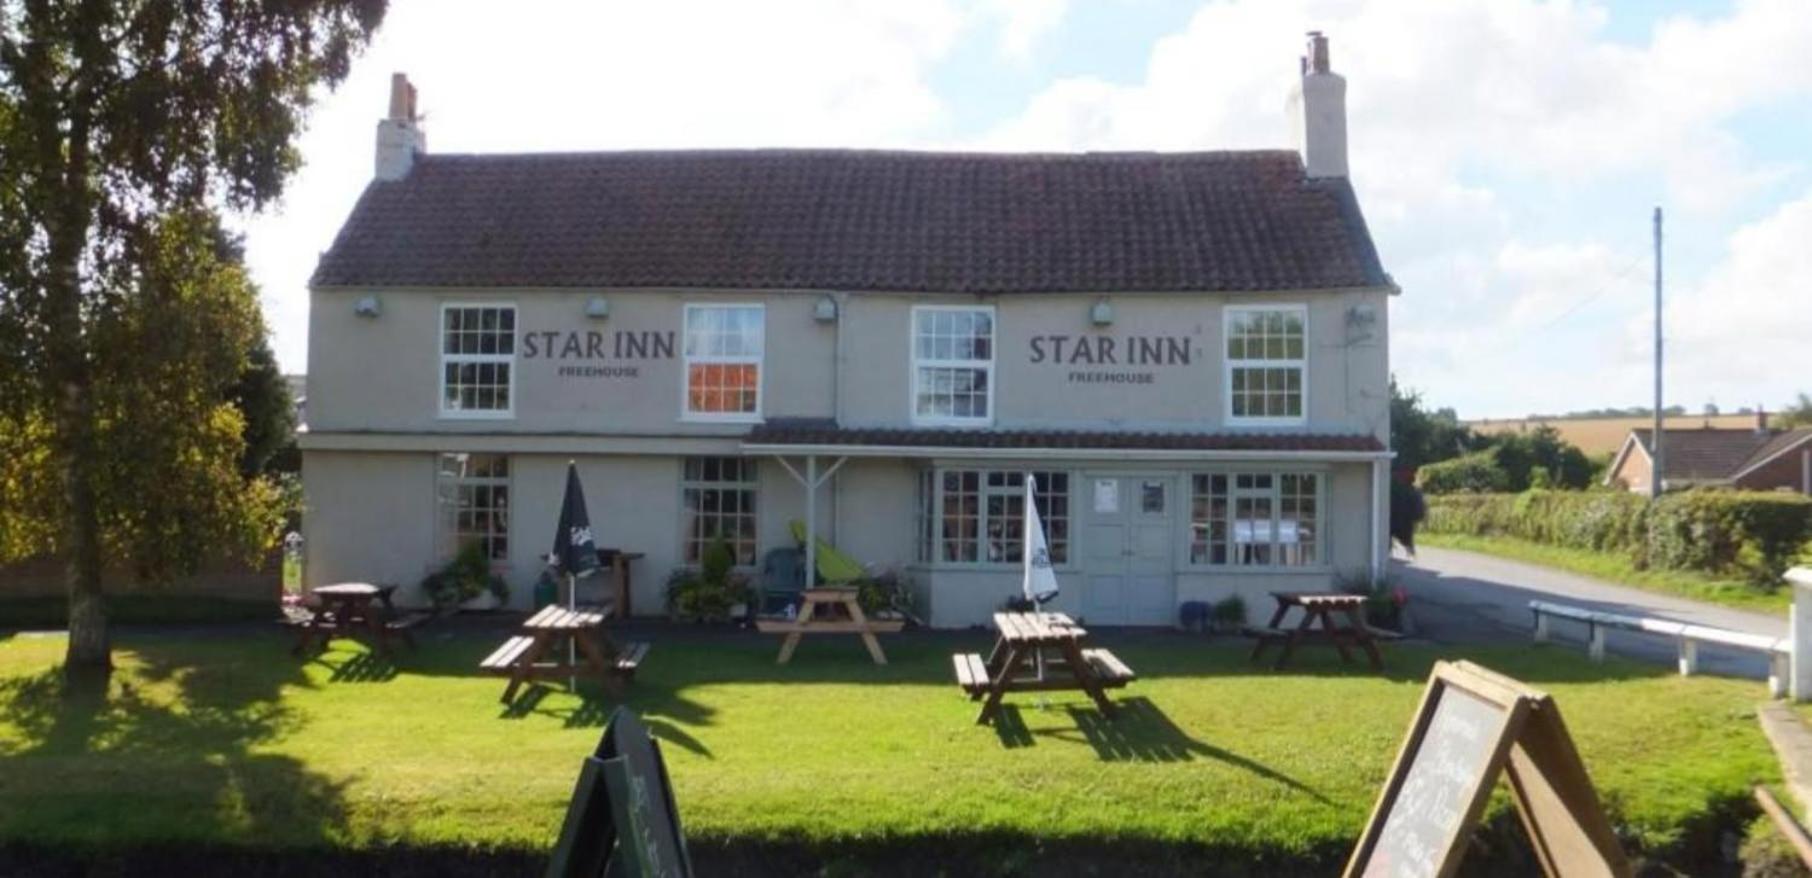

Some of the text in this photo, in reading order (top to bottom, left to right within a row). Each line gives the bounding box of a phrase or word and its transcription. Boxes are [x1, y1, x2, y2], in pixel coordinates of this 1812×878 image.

[523, 331, 676, 359] STAR INN
[1029, 335, 1191, 365] STAR INN
[558, 366, 639, 378] FREEHOUSE
[1068, 372, 1155, 384] FREEHOUSE
